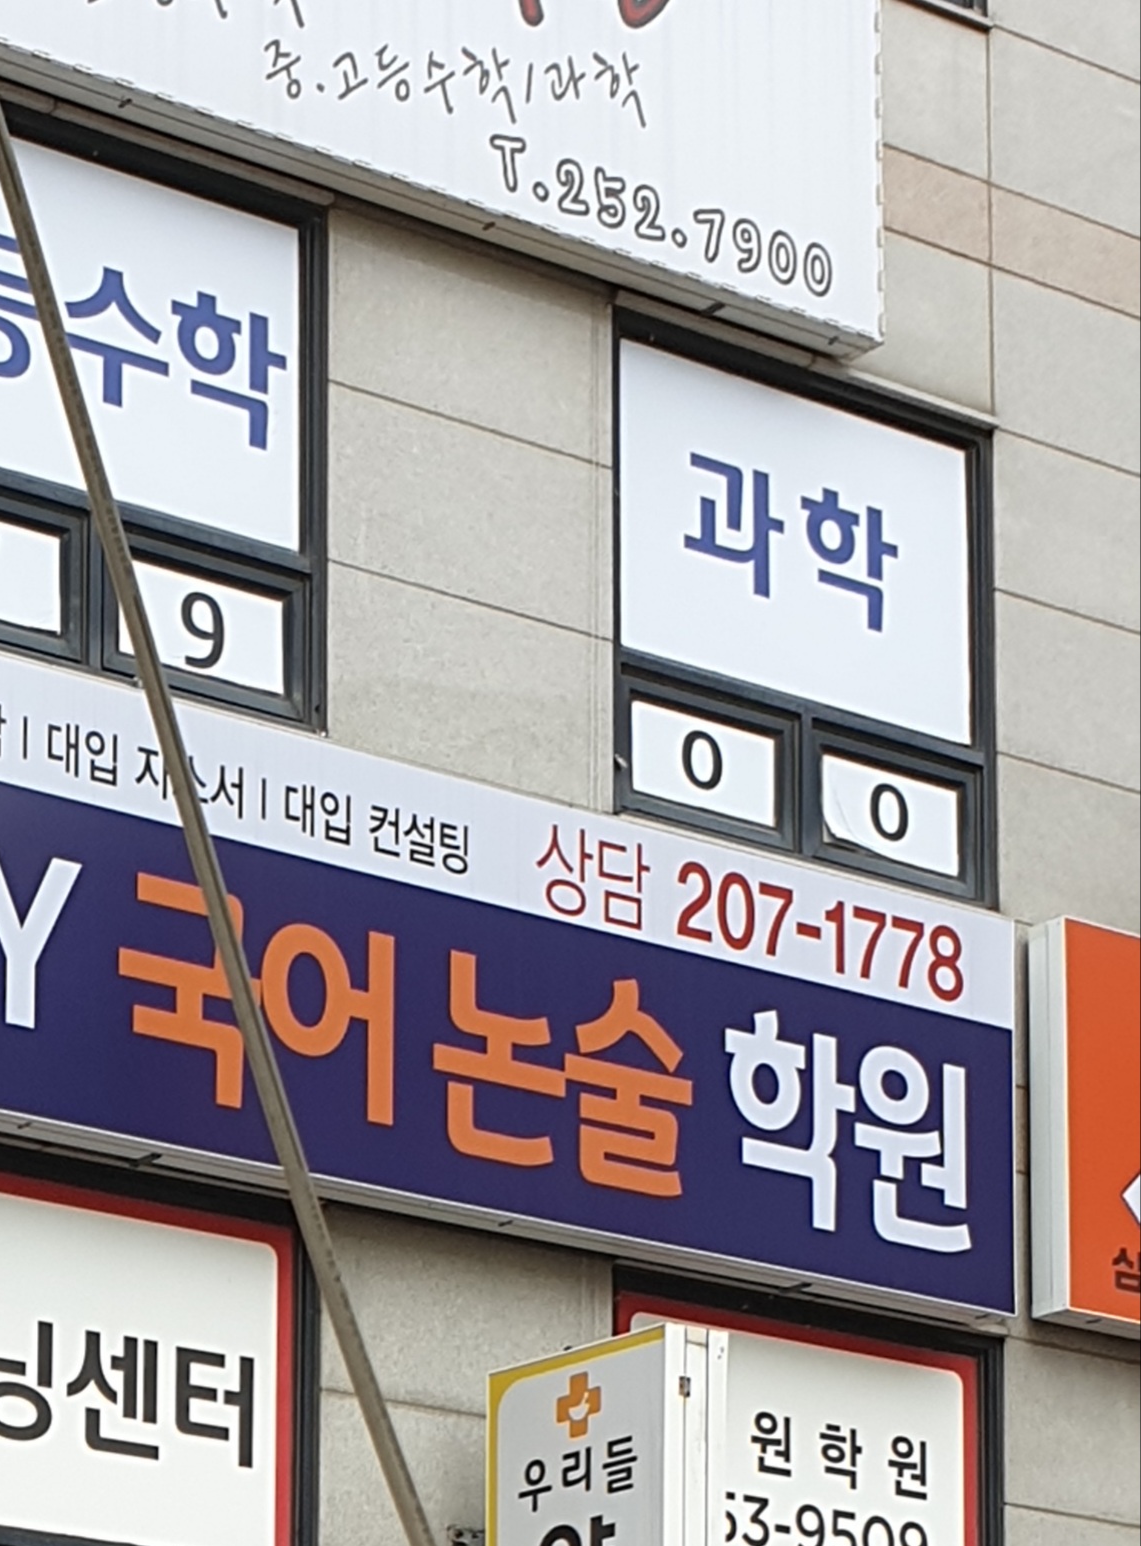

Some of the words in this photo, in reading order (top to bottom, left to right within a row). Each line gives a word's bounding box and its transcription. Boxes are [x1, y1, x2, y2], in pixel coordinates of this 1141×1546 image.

[490, 135, 833, 297] T.252.7900
[683, 452, 899, 632] 과학
[180, 591, 225, 669] 9
[47, 722, 119, 787] 대입
[284, 785, 352, 845] 대입
[369, 803, 471, 875] 컨설팅
[536, 824, 651, 932] 상담
[677, 861, 964, 1003] 207-1778
[118, 872, 396, 1127] 국어
[432, 949, 694, 1198] 논술
[725, 1010, 971, 1253] 학원
[518, 1436, 638, 1512] 우리들
